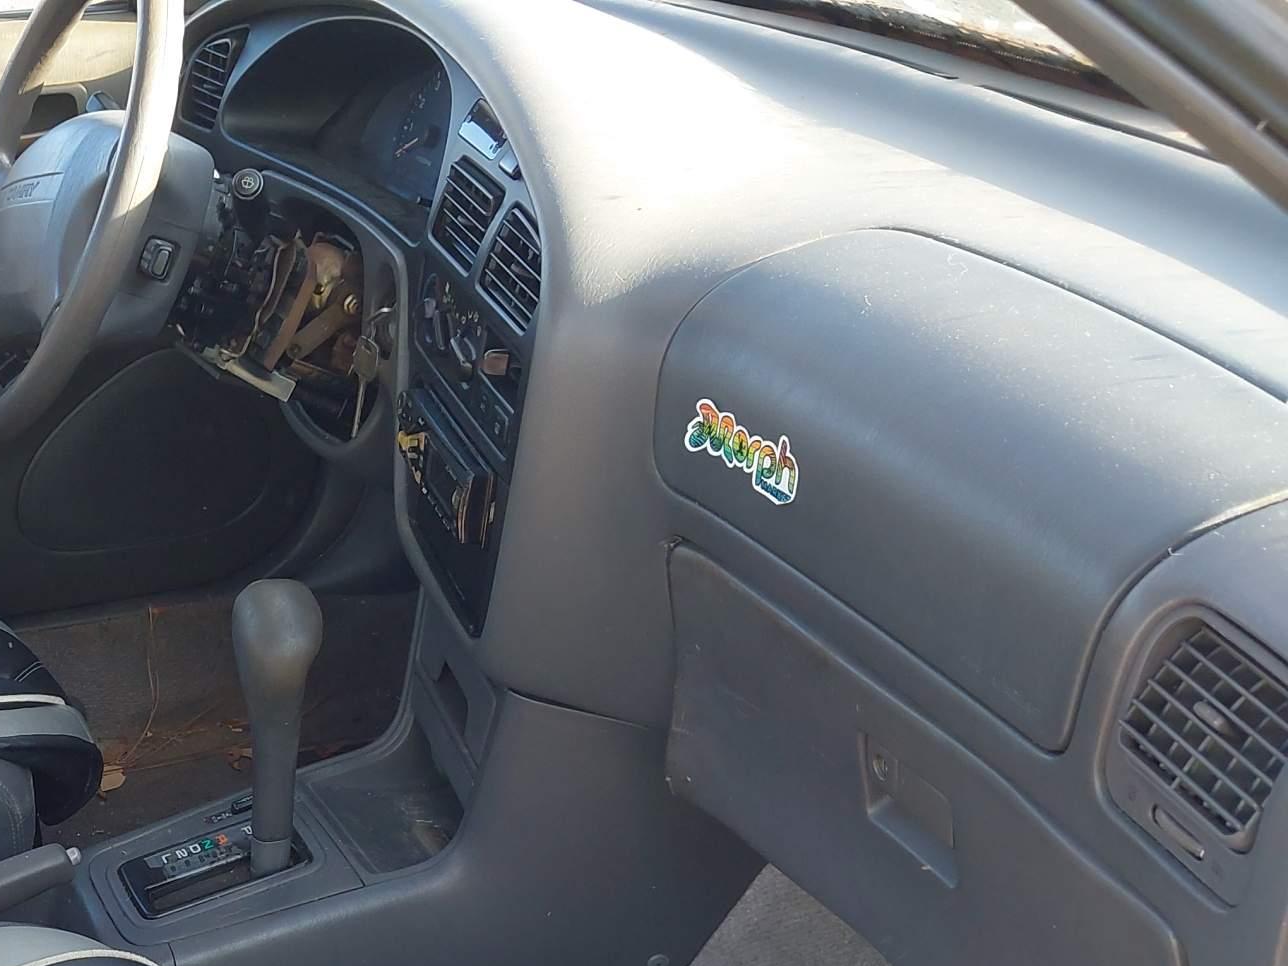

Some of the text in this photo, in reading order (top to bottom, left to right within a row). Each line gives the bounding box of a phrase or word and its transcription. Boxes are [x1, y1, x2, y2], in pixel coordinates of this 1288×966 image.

[241, 825, 252, 835] P
[189, 843, 202, 854] D
[201, 839, 214, 849] N
[161, 853, 172, 864] L
